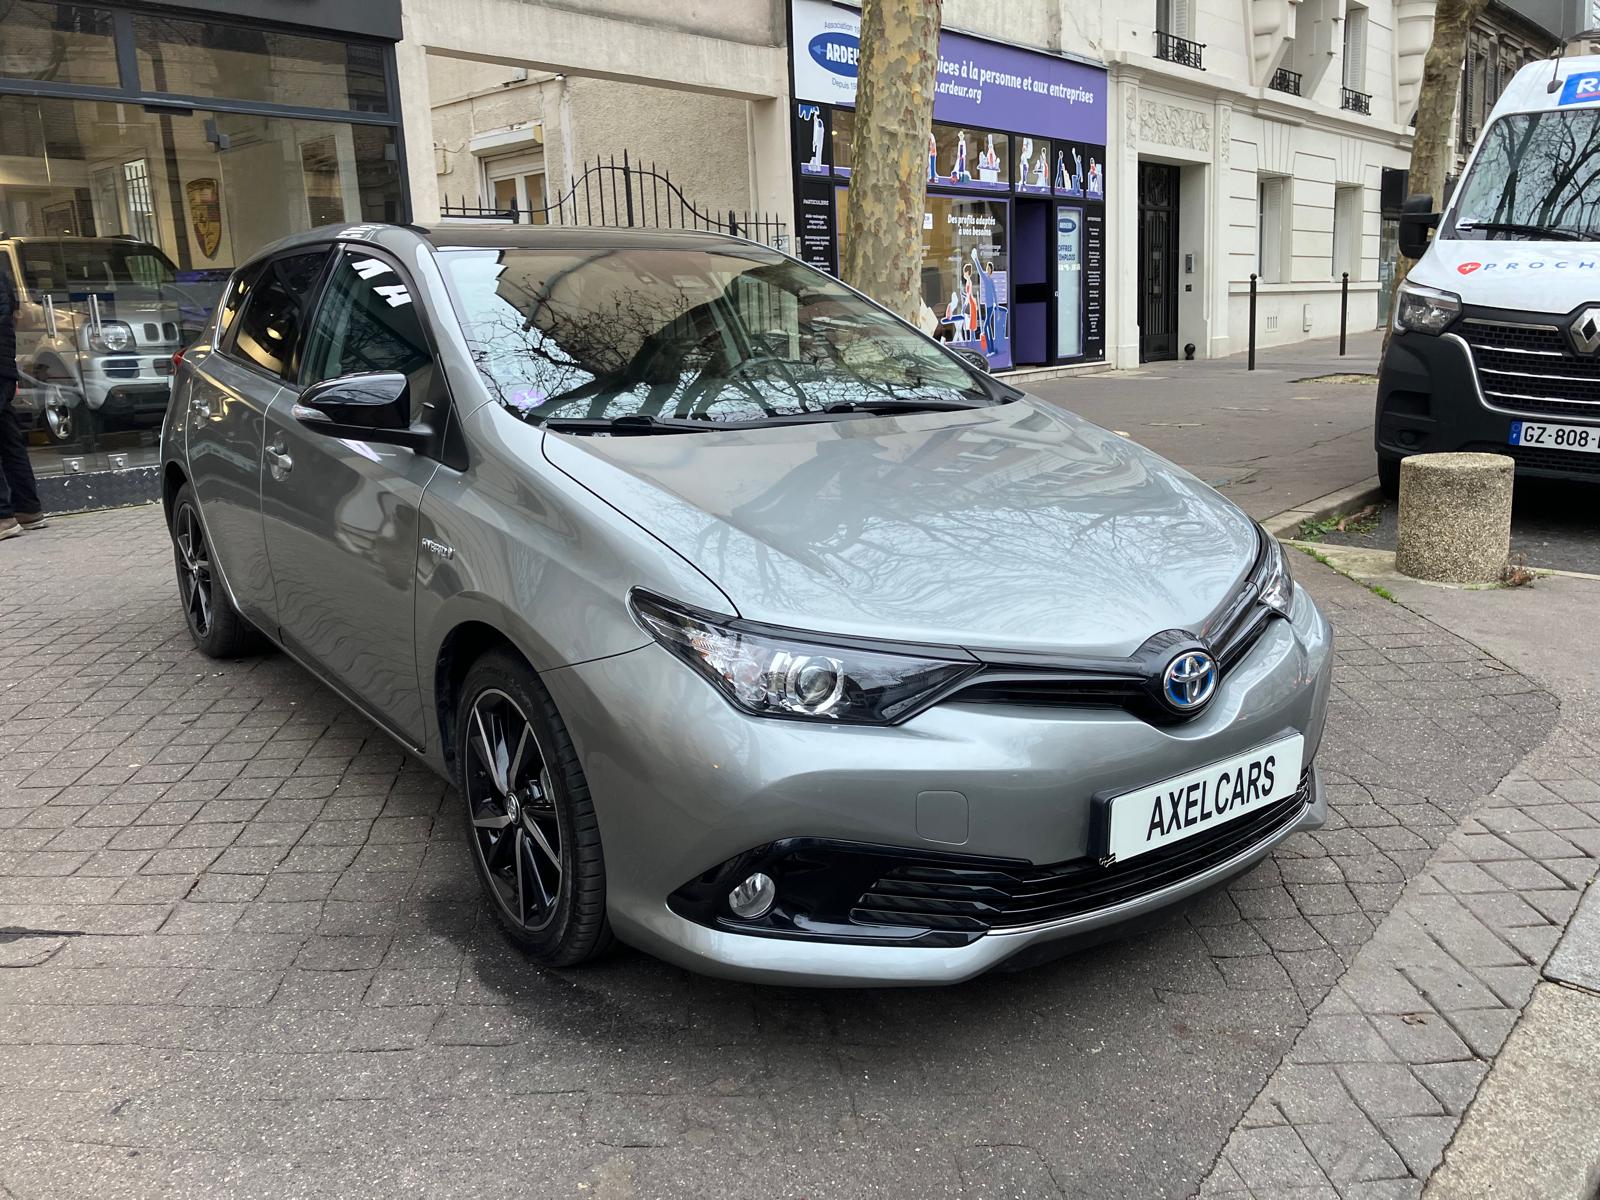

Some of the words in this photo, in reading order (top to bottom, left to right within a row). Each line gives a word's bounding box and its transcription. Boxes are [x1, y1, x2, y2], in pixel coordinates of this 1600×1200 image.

[826, 42, 860, 66] ARDEU
[832, 77, 850, 90] Depuis
[961, 59, 967, 78] à
[969, 61, 978, 80] la
[980, 68, 1021, 89] personne
[1023, 77, 1032, 91] et
[1033, 80, 1048, 94] aux
[1049, 83, 1094, 104] entreprises
[1576, 77, 1600, 94] R
[947, 213, 957, 224] Des
[958, 214, 975, 227] profils
[976, 214, 996, 229] adaptés
[958, 225, 962, 236] à
[963, 228, 972, 236] vos
[972, 226, 992, 237] besoins
[1523, 426, 1600, 448] GZ-808-
[1146, 755, 1276, 842] AXELCARS
